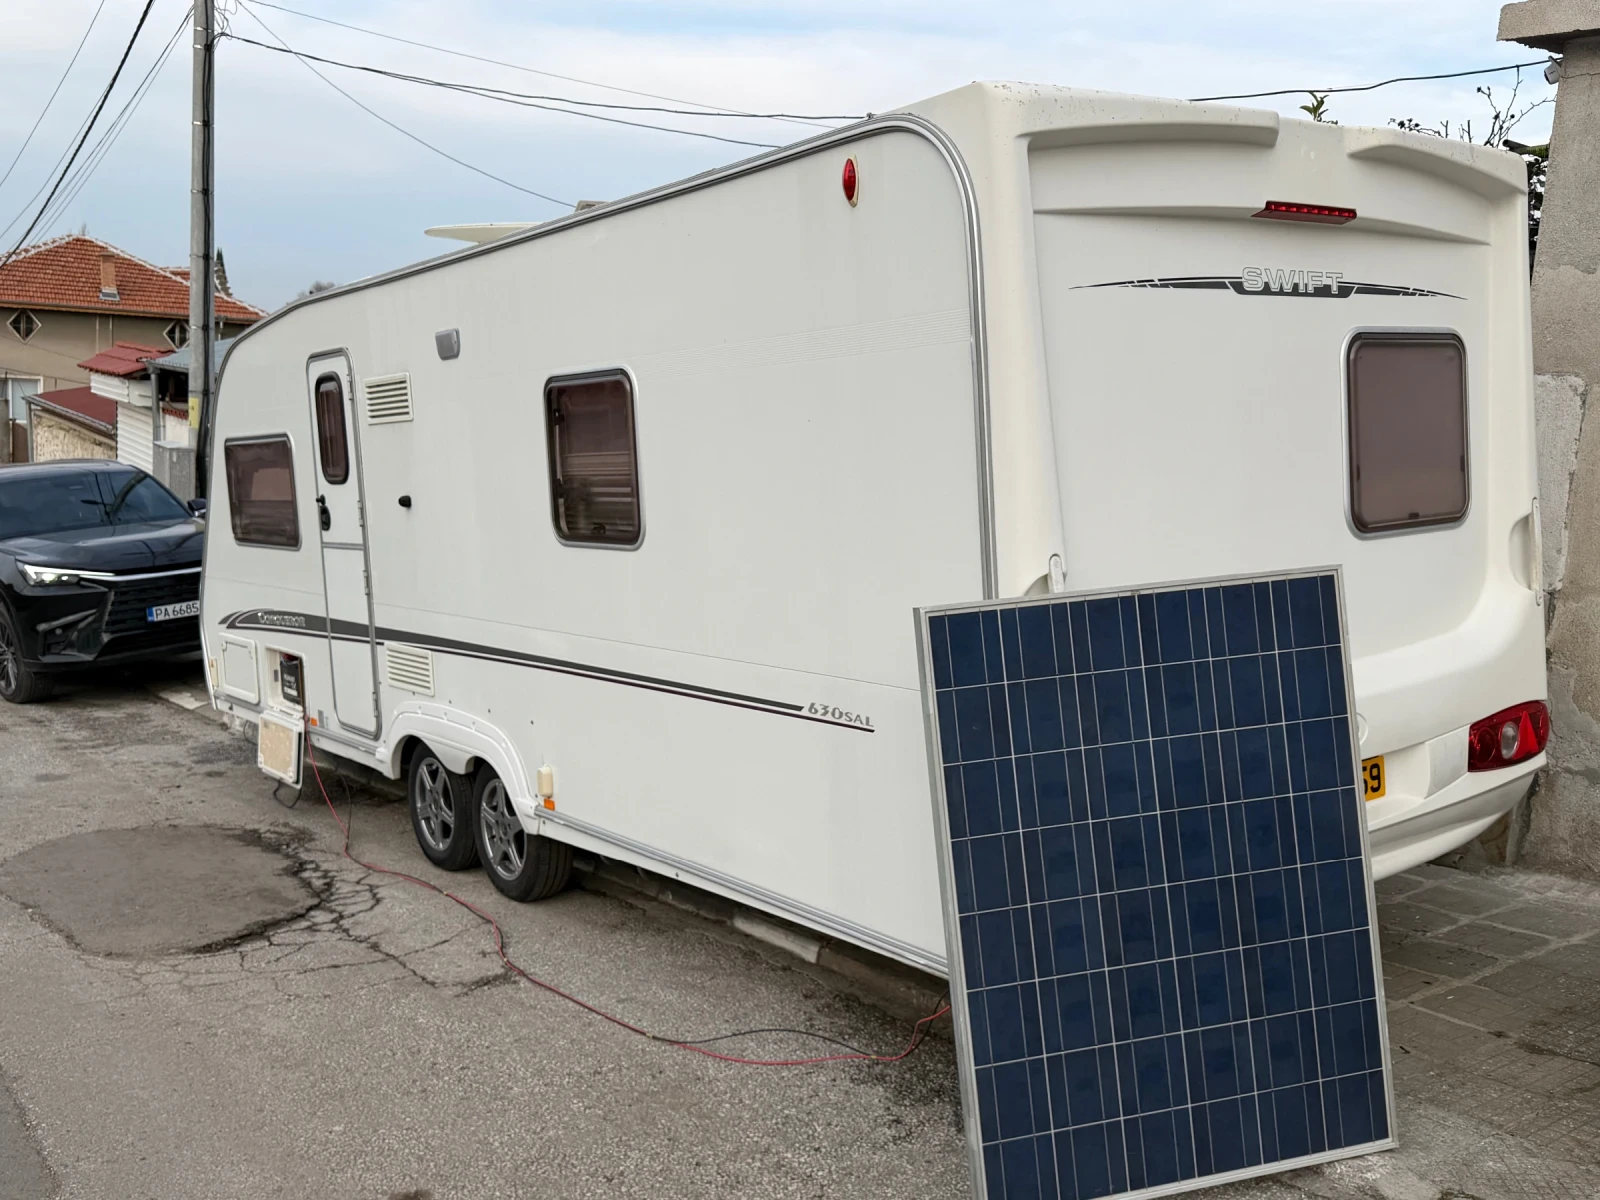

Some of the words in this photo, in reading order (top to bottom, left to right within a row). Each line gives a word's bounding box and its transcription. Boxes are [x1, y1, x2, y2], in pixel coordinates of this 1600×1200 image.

[1242, 266, 1343, 294] SWIFT
[155, 608, 170, 619] PA
[172, 602, 199, 616] 6685
